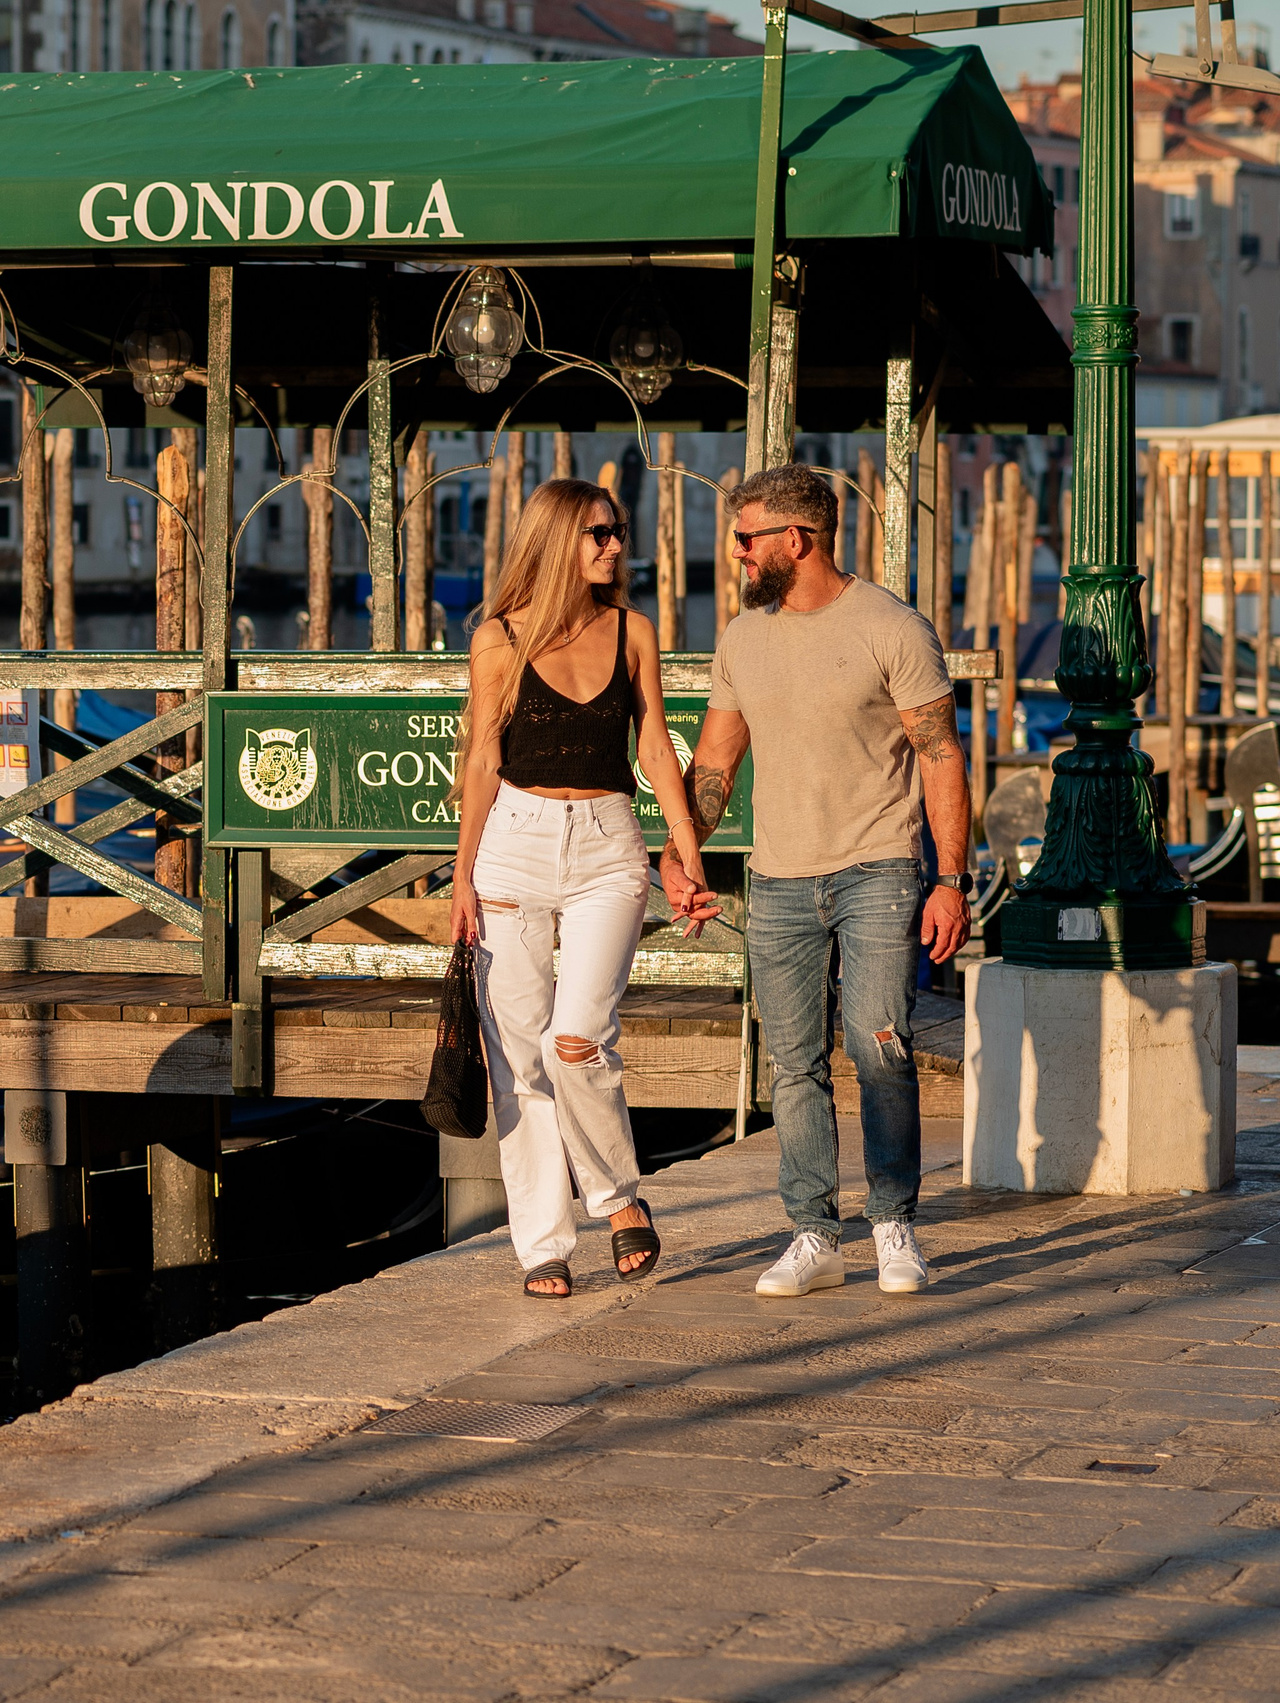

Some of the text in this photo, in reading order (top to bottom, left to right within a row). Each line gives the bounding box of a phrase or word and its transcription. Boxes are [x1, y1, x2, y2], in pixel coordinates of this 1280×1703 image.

[79, 178, 464, 242] GONDOLA
[942, 162, 1022, 232] GONDOLA
[260, 731, 296, 742] VENEZIA
[665, 713, 699, 725] wearing
[242, 763, 282, 808] ASSOCIAZIONE
